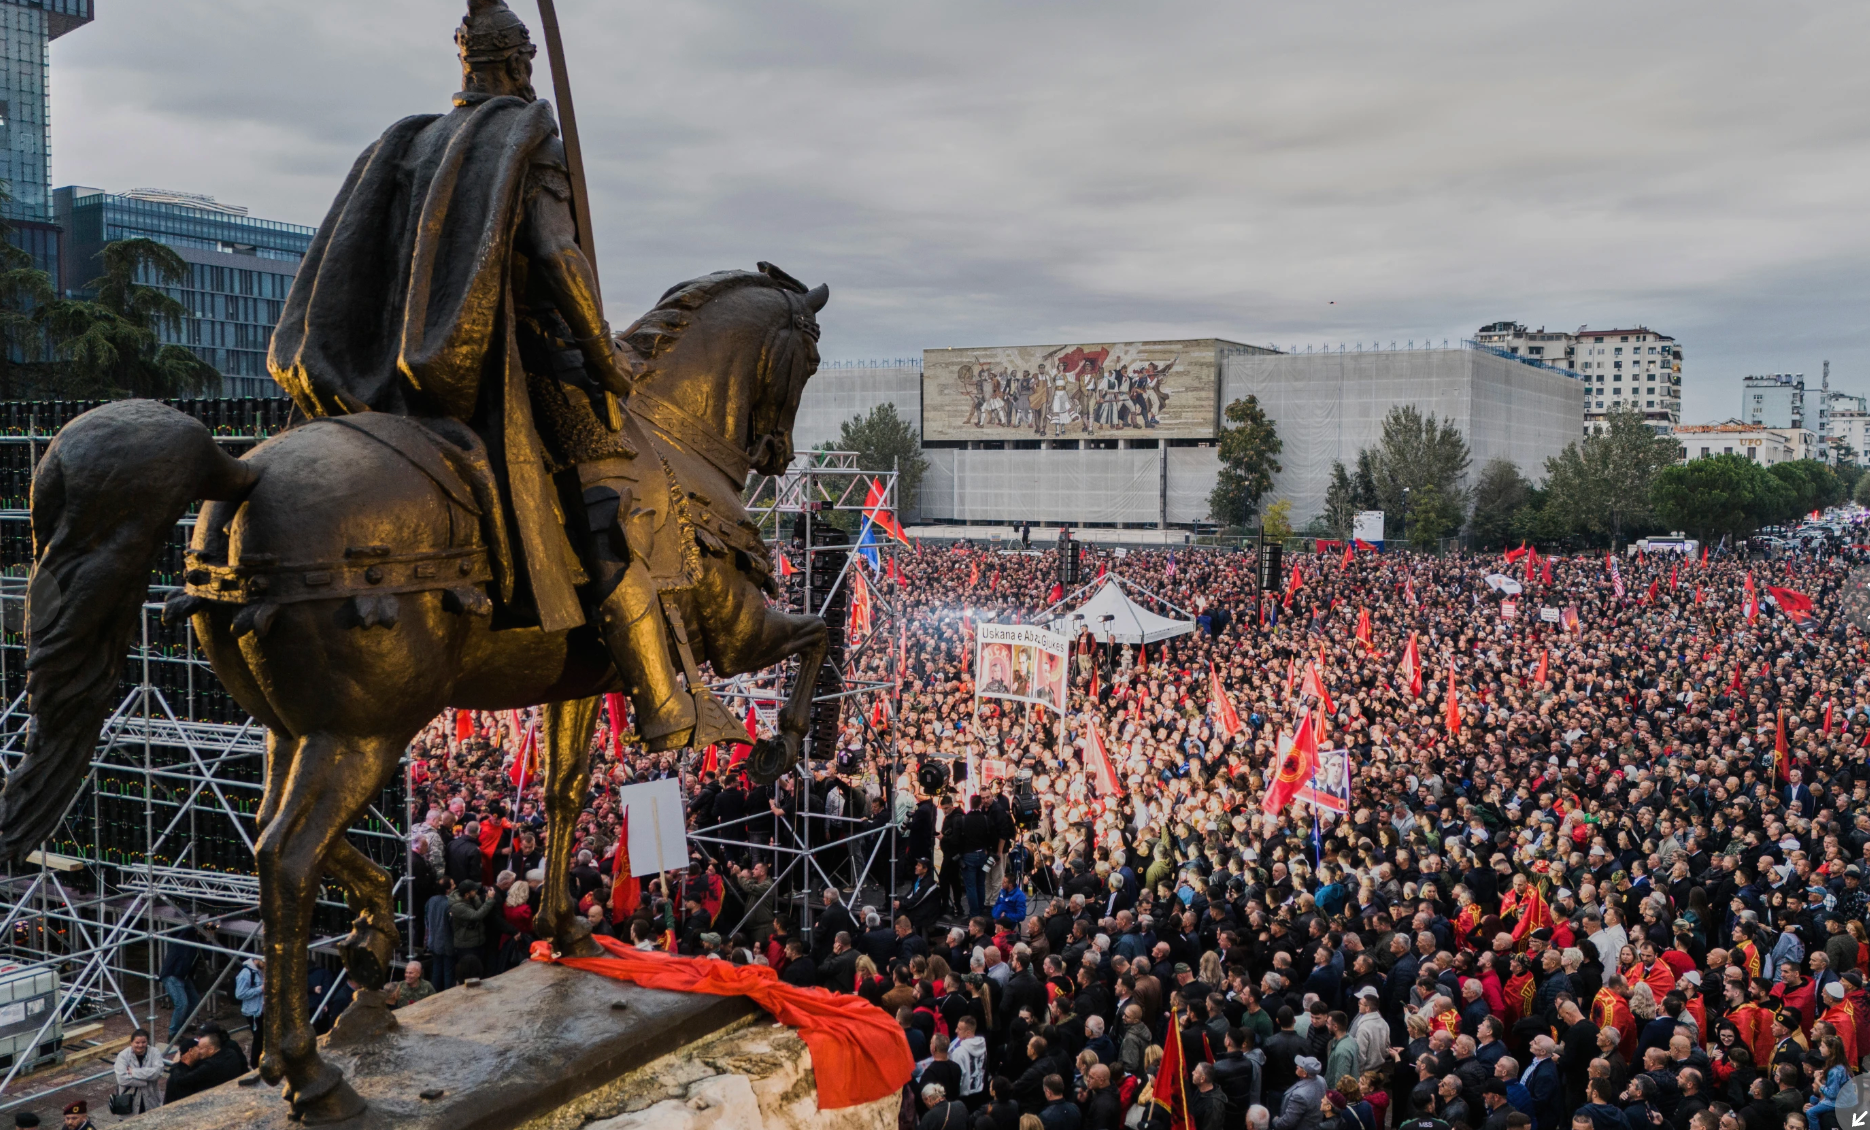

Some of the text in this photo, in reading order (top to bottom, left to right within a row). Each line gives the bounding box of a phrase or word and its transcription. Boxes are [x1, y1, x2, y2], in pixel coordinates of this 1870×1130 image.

[1740, 438, 1763, 446] UFO
[982, 627, 1016, 640] Uskana
[1017, 632, 1022, 641] e
